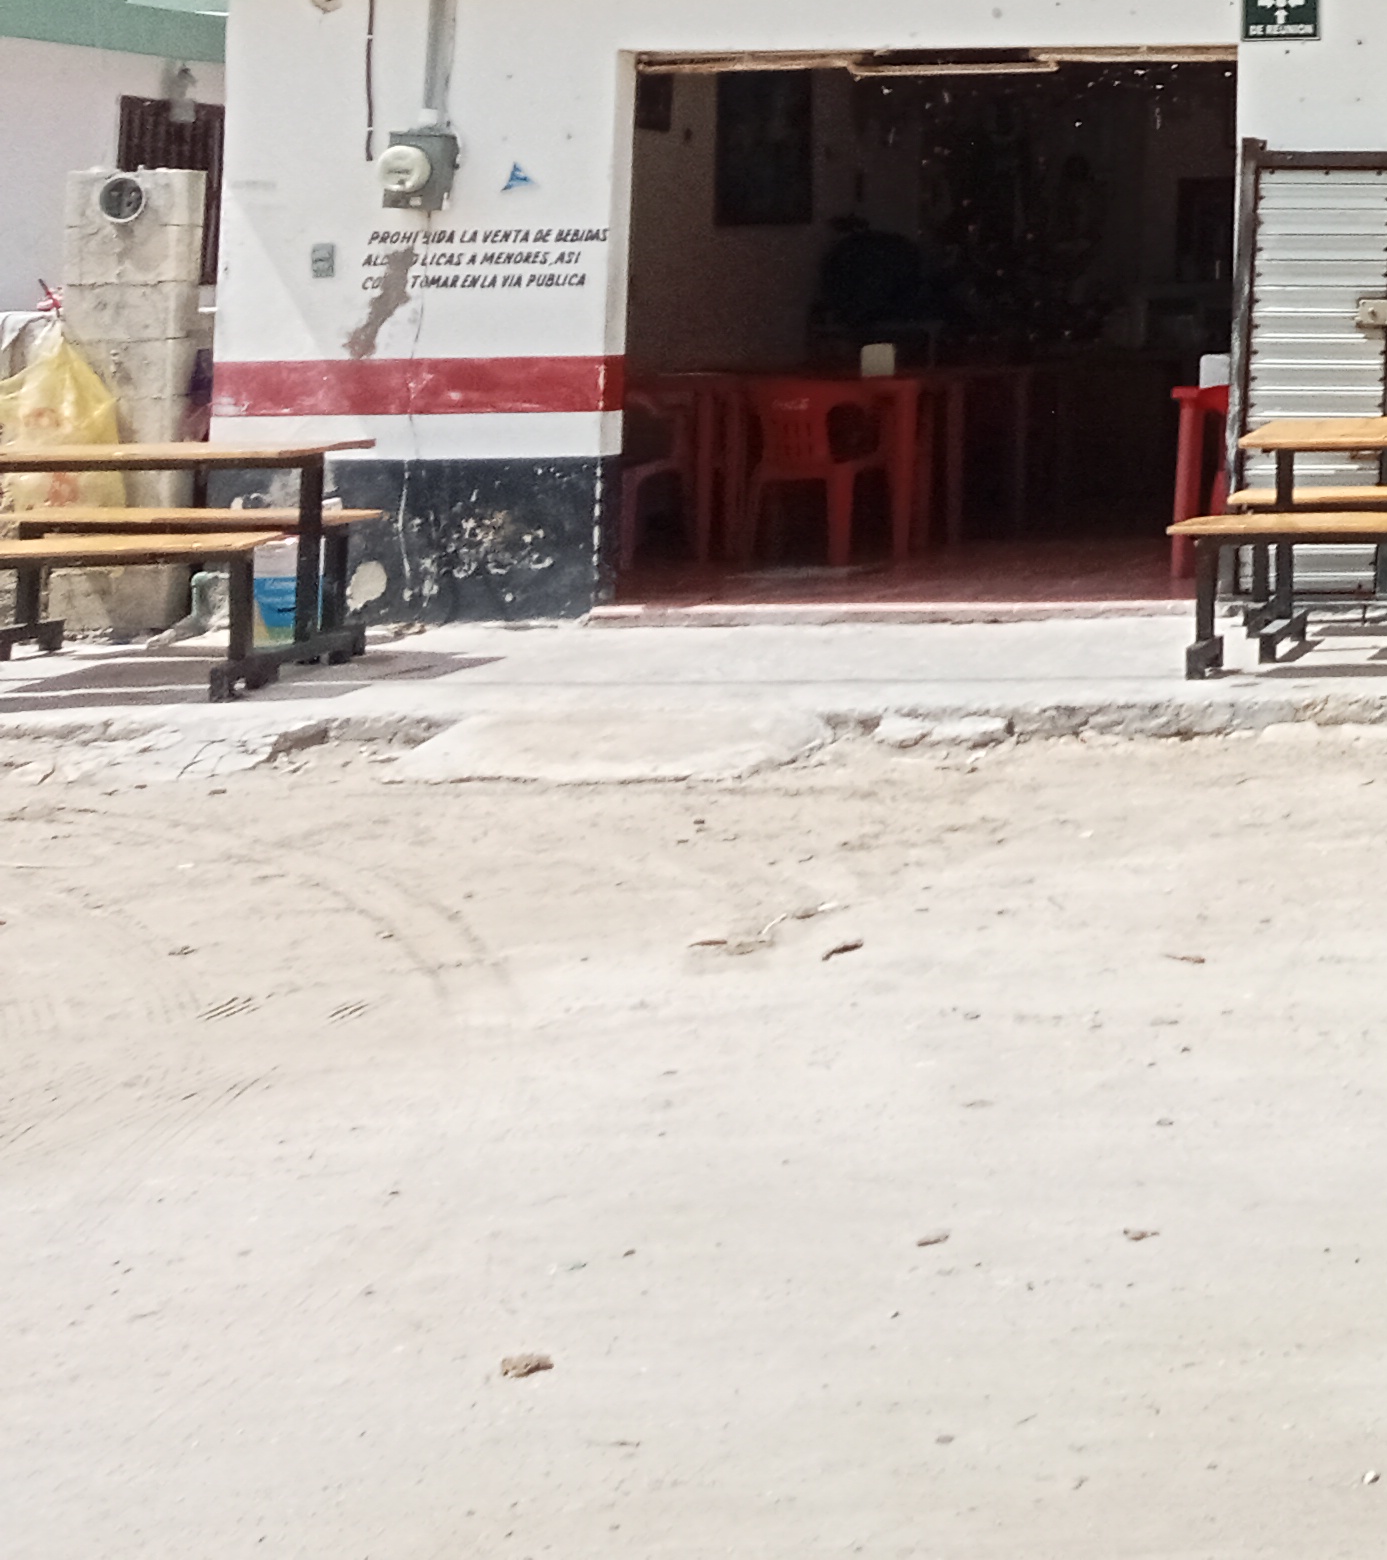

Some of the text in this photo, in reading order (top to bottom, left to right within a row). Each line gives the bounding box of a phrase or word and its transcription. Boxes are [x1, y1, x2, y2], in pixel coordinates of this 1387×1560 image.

[459, 229, 479, 244] LA
[482, 228, 530, 244] VENTA
[532, 228, 551, 243] DE
[554, 228, 610, 243] BEBIDAS
[467, 251, 477, 266] A
[501, 273, 522, 288] VIA
[525, 273, 587, 288] PUBLICA
